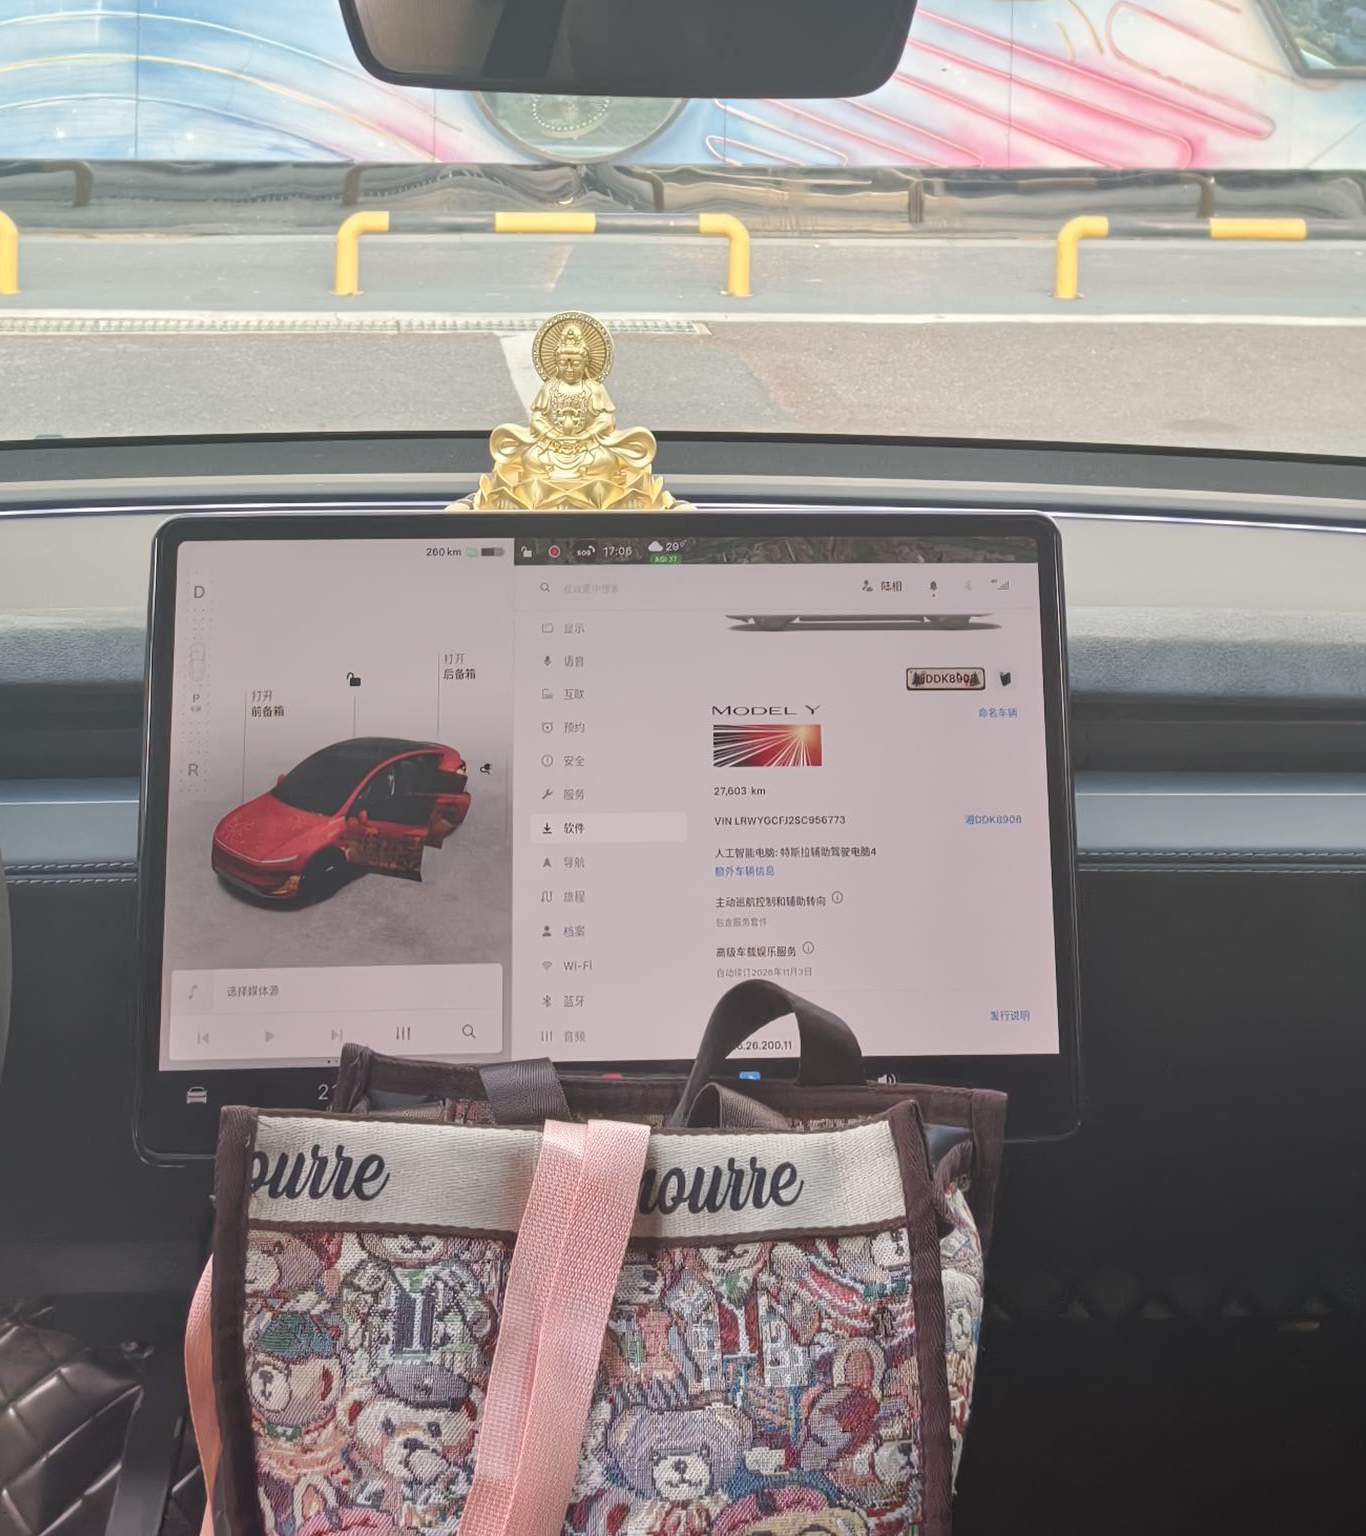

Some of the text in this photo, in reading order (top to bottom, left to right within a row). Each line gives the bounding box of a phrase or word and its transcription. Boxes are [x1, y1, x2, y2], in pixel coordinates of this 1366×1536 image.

[447, 547, 462, 556] km
[193, 585, 205, 599] D
[564, 623, 585, 634] 显示
[443, 652, 465, 664] 打开
[564, 655, 584, 667] 语音
[443, 668, 476, 680] 后备箱
[192, 693, 200, 704] P
[251, 690, 273, 702] 打开
[564, 689, 585, 701] 互联
[251, 705, 285, 717] 前备箱
[712, 704, 821, 716] MODEL Y
[978, 707, 1018, 718] 命名车辆
[563, 721, 586, 734] 预约
[563, 755, 585, 767] 安全
[188, 763, 199, 777] R
[563, 788, 585, 800] 服务
[714, 786, 766, 797] 27,603 km
[714, 816, 732, 825] VIN
[563, 822, 584, 835] 软件
[563, 856, 585, 869] 导航
[563, 890, 585, 903] 旅程
[716, 896, 826, 908] 主动巡航控制和辅助转向
[563, 925, 585, 937] 档案
[716, 946, 796, 957] 高级车载娱乐服务
[563, 960, 592, 970] Wi-Fi
[227, 985, 279, 997] 选择媒体源
[563, 995, 585, 1008] 蓝牙
[990, 1010, 1030, 1021] 发行说明
[564, 1030, 585, 1043] 音频
